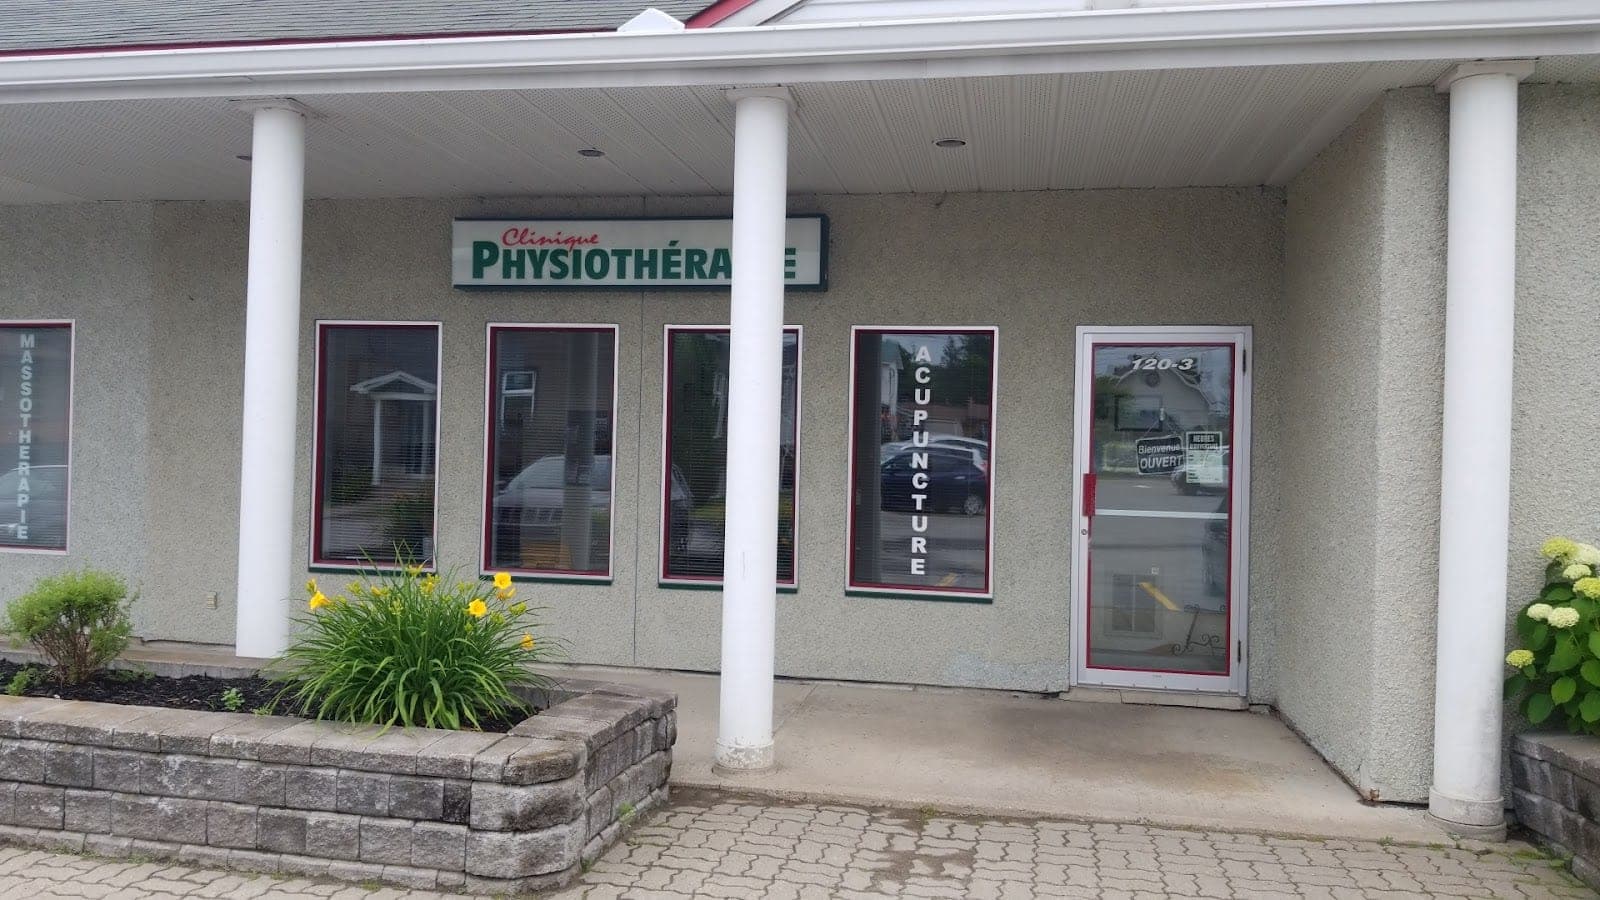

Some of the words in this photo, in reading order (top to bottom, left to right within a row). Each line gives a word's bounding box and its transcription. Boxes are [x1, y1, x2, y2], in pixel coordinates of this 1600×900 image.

[502, 228, 599, 251] Clinique
[472, 240, 797, 280] PHYSIOTHÉRAE
[1132, 358, 1194, 370] 120-3
[17, 334, 35, 540] MASSOTHERAPIE
[911, 346, 931, 575] ACUPUNCTURE
[1140, 454, 1184, 469] OUVERT
